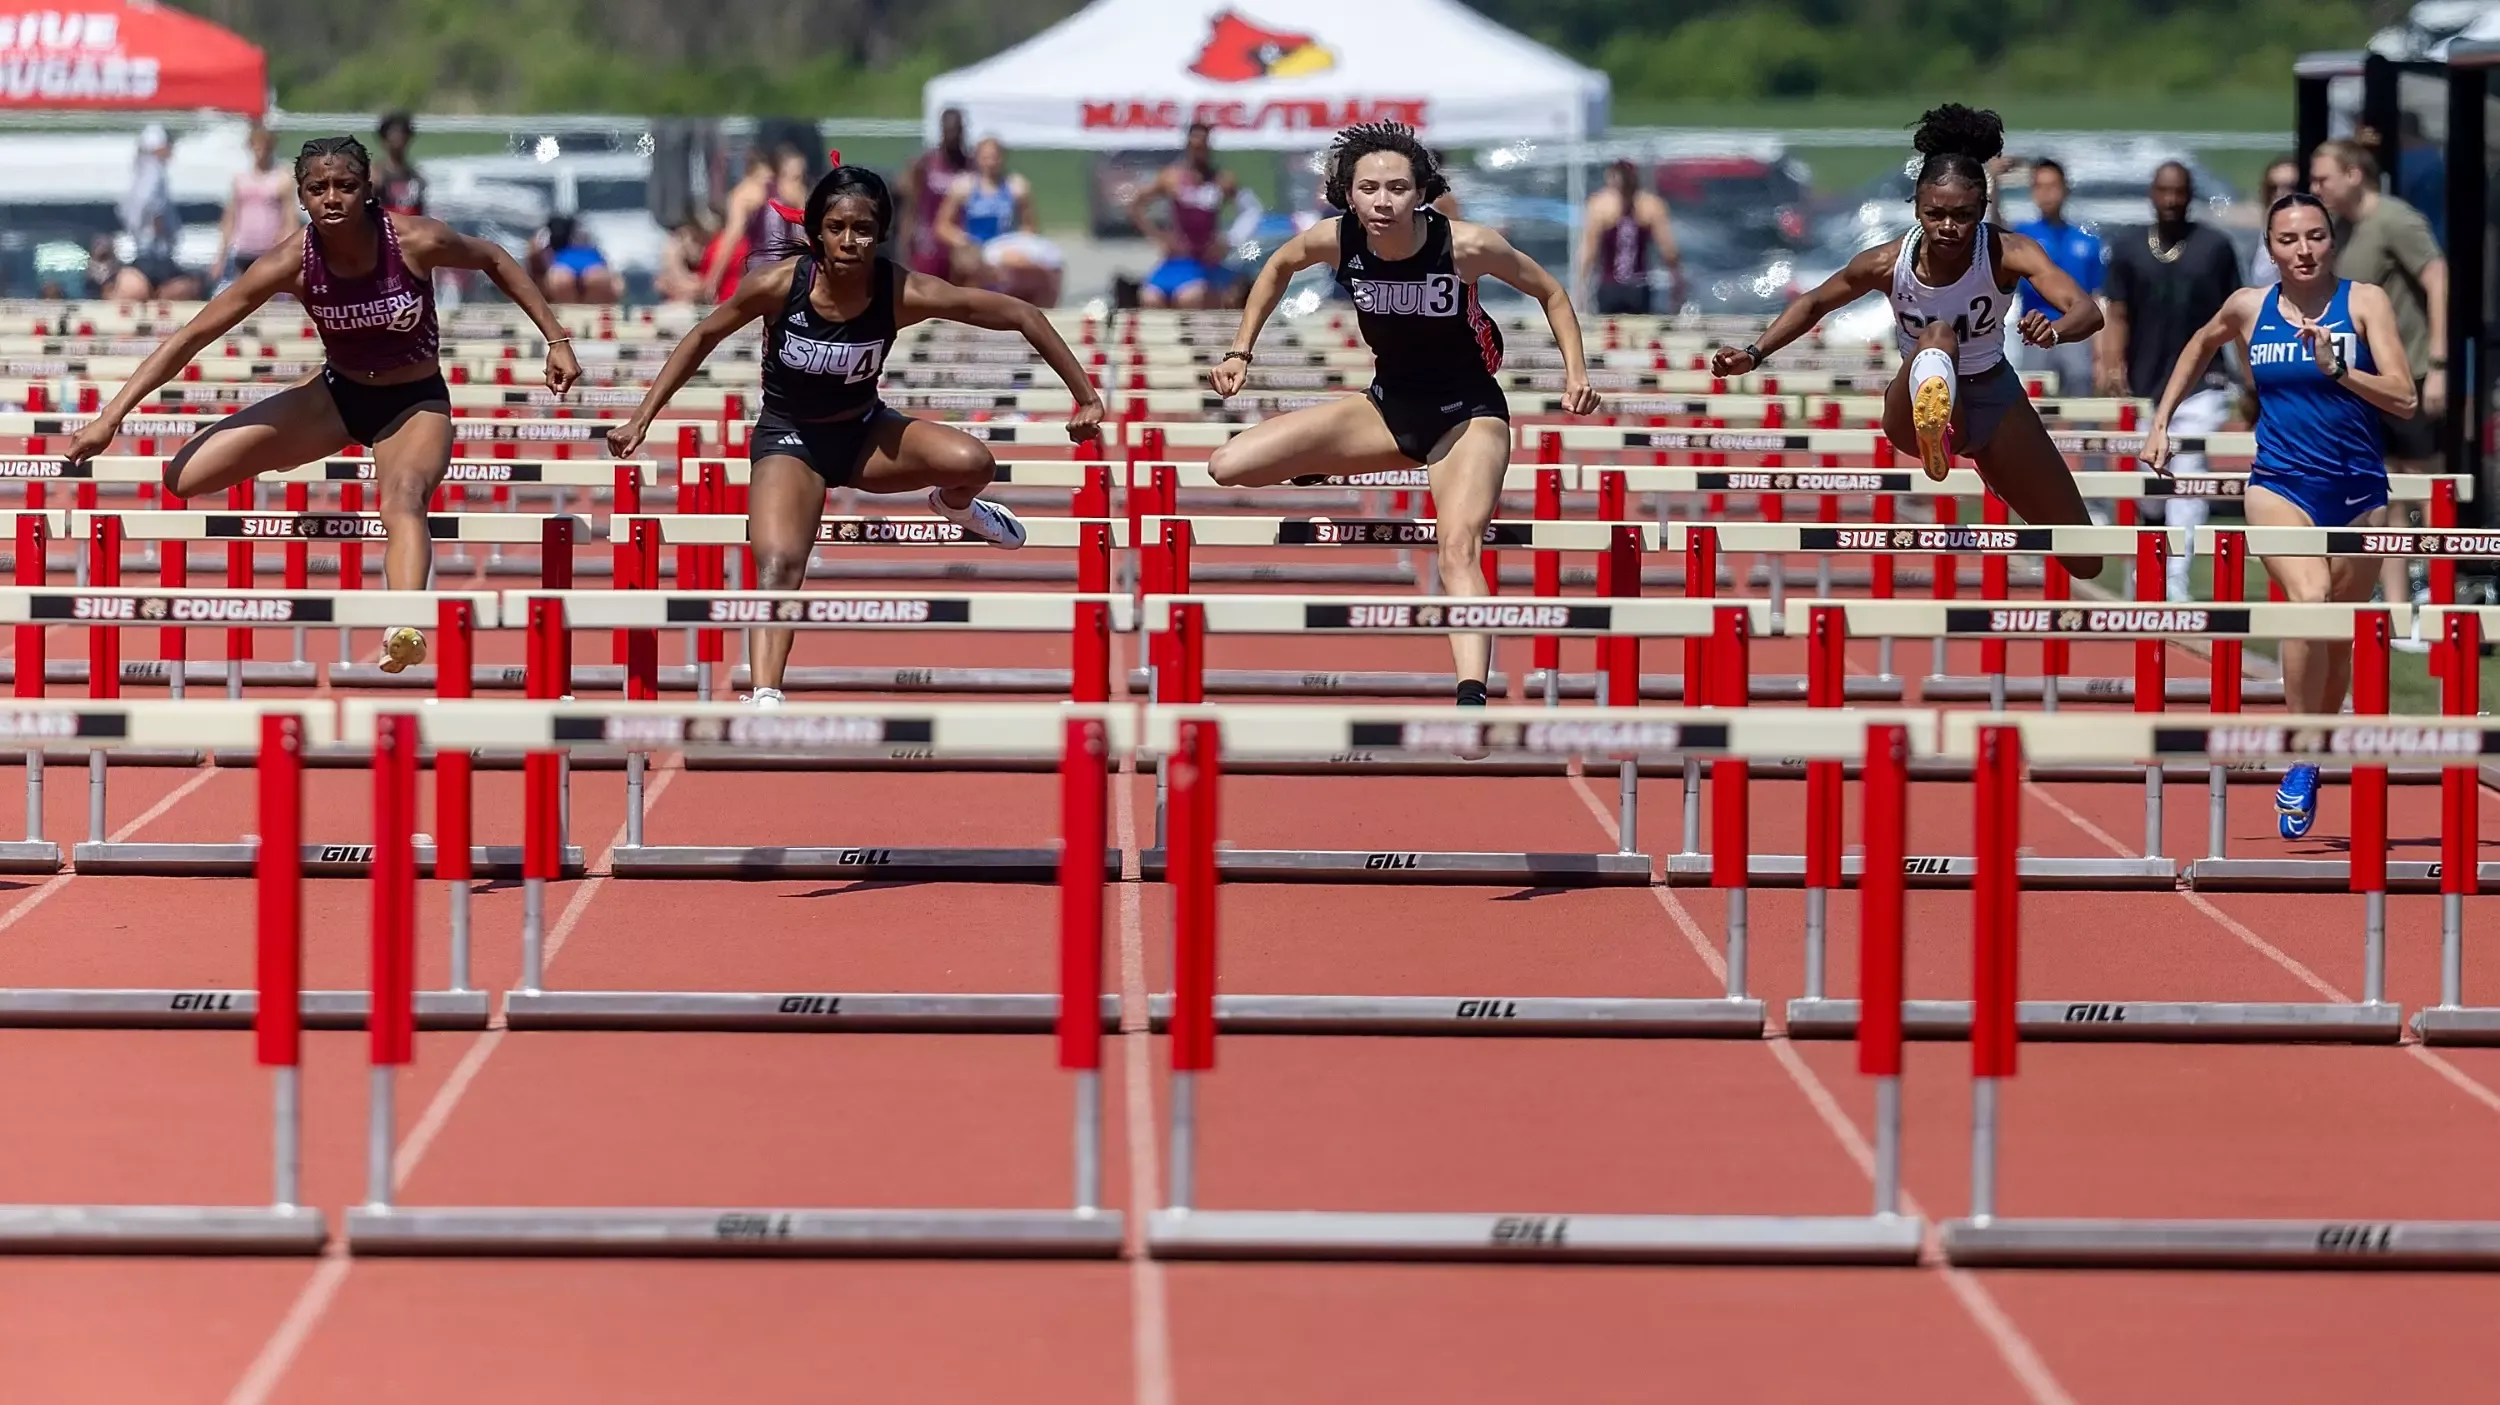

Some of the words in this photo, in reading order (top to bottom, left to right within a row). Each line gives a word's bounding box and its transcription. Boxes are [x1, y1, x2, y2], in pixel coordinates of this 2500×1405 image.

[1351, 278, 1427, 314] SIU
[1429, 276, 1454, 313] 3
[312, 291, 414, 320] SOUTHERN
[392, 299, 420, 331] 5
[1969, 295, 1997, 331] 2
[324, 311, 398, 331] ILLINOI
[851, 347, 876, 379] 4
[2250, 342, 2299, 366] SAINT
[121, 421, 196, 435] COUGARS
[456, 424, 494, 440] SIUE
[516, 425, 592, 440] COUGARS
[1649, 433, 1688, 449] SIUE
[1709, 434, 1786, 450] COUGARS
[1727, 474, 1771, 490] SIUE
[1796, 475, 1882, 491] COUGARS
[2174, 479, 2217, 495] SIUE
[242, 518, 293, 535] SIUE
[865, 524, 963, 541] COUGARS
[1316, 525, 1366, 542] SIUE
[1837, 530, 1887, 549] SIUE
[1918, 531, 2018, 550] COUGARS
[2363, 534, 2413, 553] SIUE
[74, 599, 135, 619] SIUE
[172, 600, 292, 621] COUGARS
[710, 600, 771, 621] SIUE
[808, 601, 929, 622] COUGARS
[1349, 606, 1411, 626] SIUE
[1447, 607, 1569, 627] COUGARS
[1989, 609, 2049, 630] SIUE
[2089, 610, 2208, 632] COUGARS
[2207, 727, 2285, 756] SIUE
[2330, 729, 2482, 757] COUGARS
[321, 845, 374, 862] GILL
[838, 849, 891, 865] GILL
[1364, 853, 1417, 869] GILL
[170, 993, 232, 1010] GILL
[779, 996, 842, 1014] GILL
[1456, 1000, 1517, 1017] GILL
[2064, 1003, 2126, 1021] GILL
[2318, 1224, 2391, 1248] GILL
